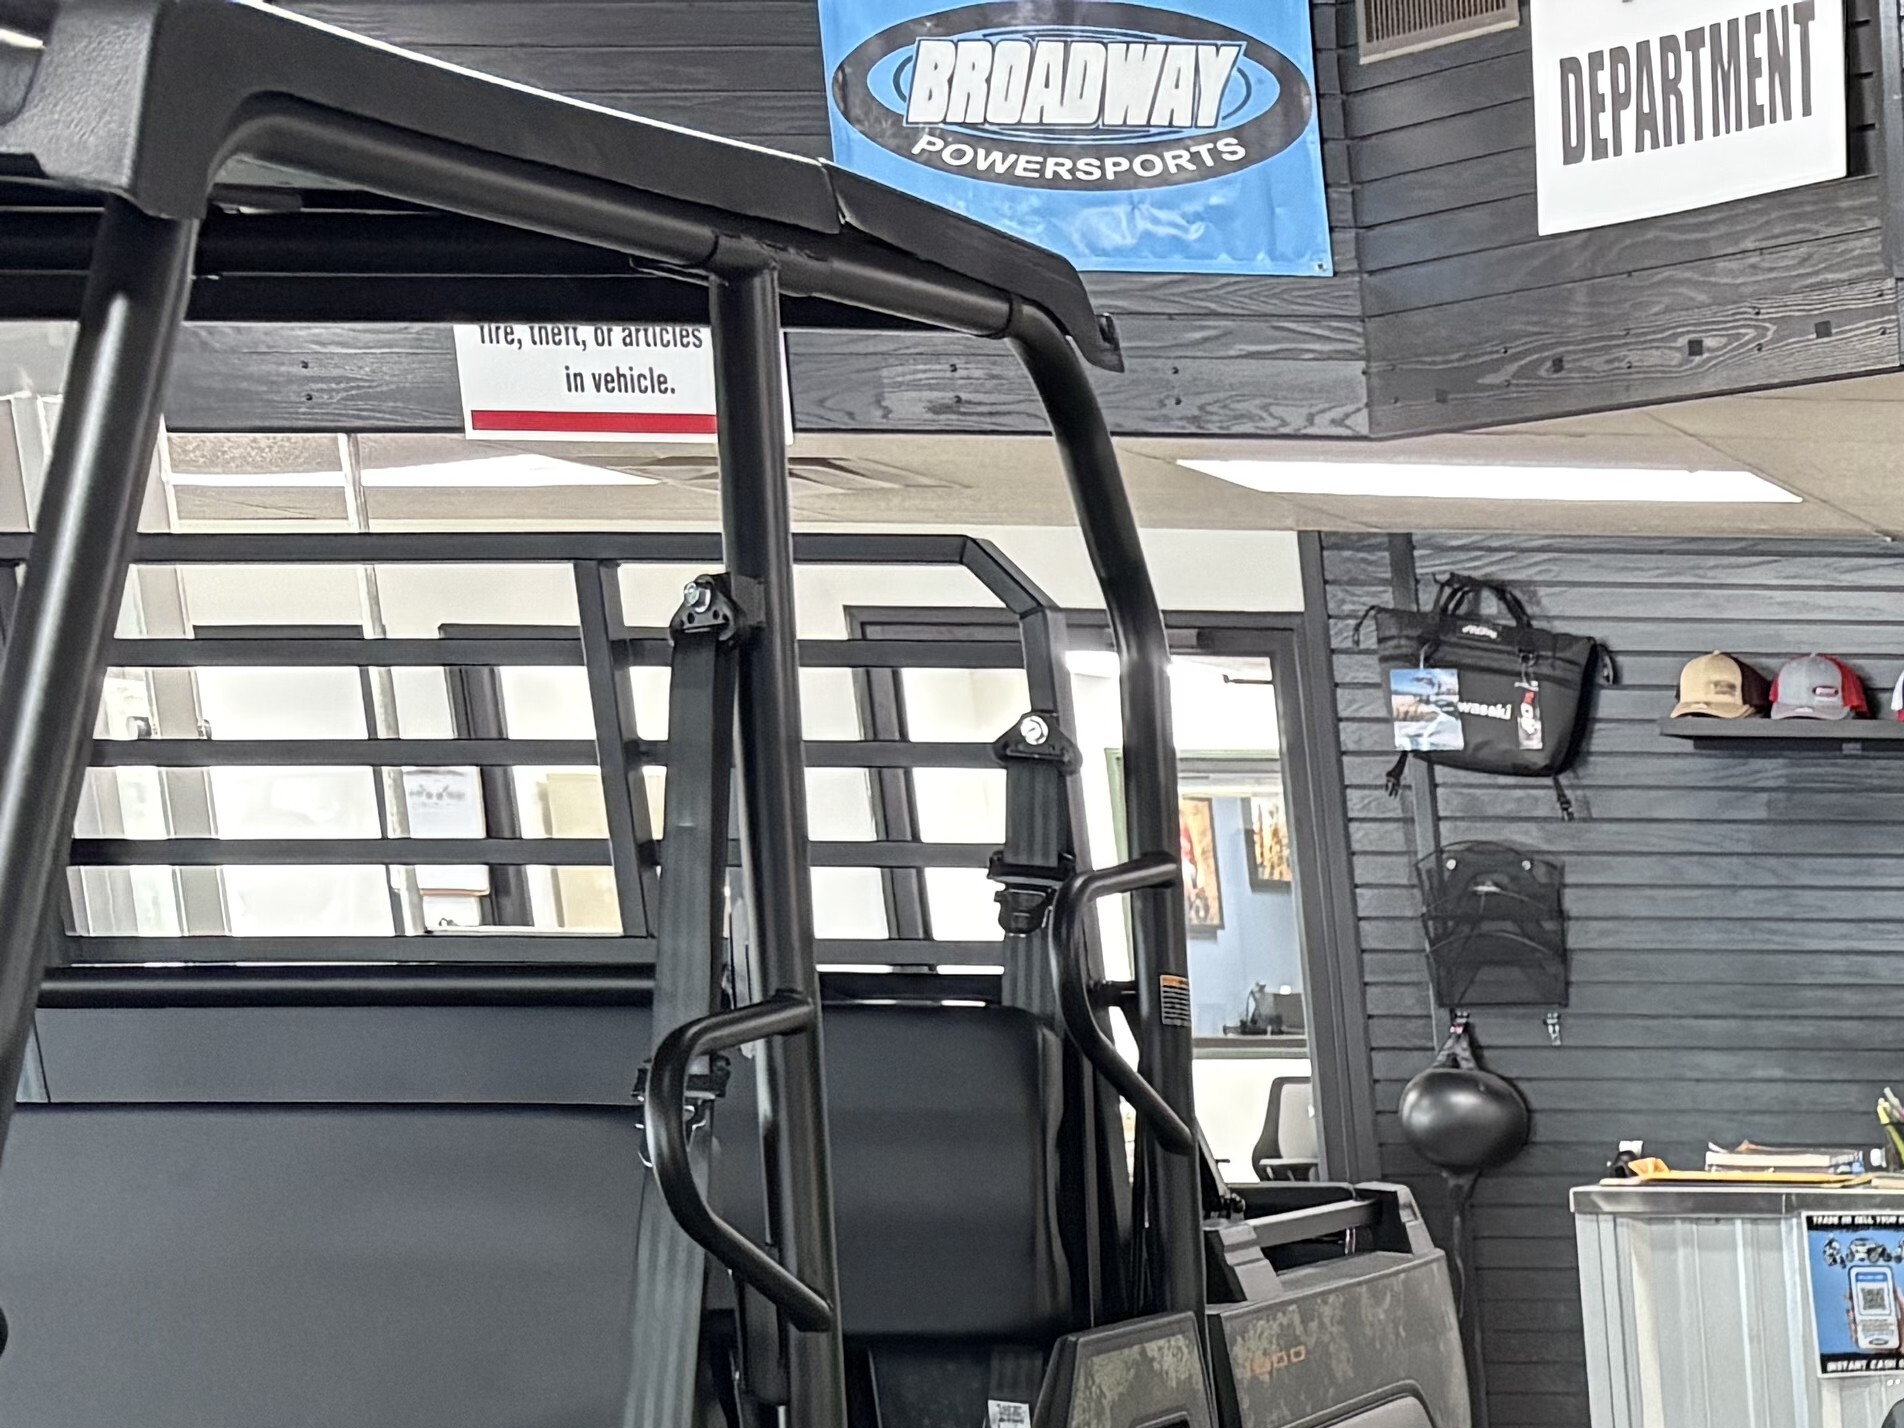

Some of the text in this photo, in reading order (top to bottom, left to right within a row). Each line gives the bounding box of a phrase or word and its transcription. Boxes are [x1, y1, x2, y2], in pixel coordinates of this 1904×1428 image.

[906, 39, 1242, 128] BROADWAY
[1560, 0, 1815, 166] DEPARTMENT
[911, 134, 1247, 181] POWERSPORTS
[593, 326, 614, 347] or
[564, 364, 676, 394] in vehicle.
[1457, 702, 1512, 720] wasaki
